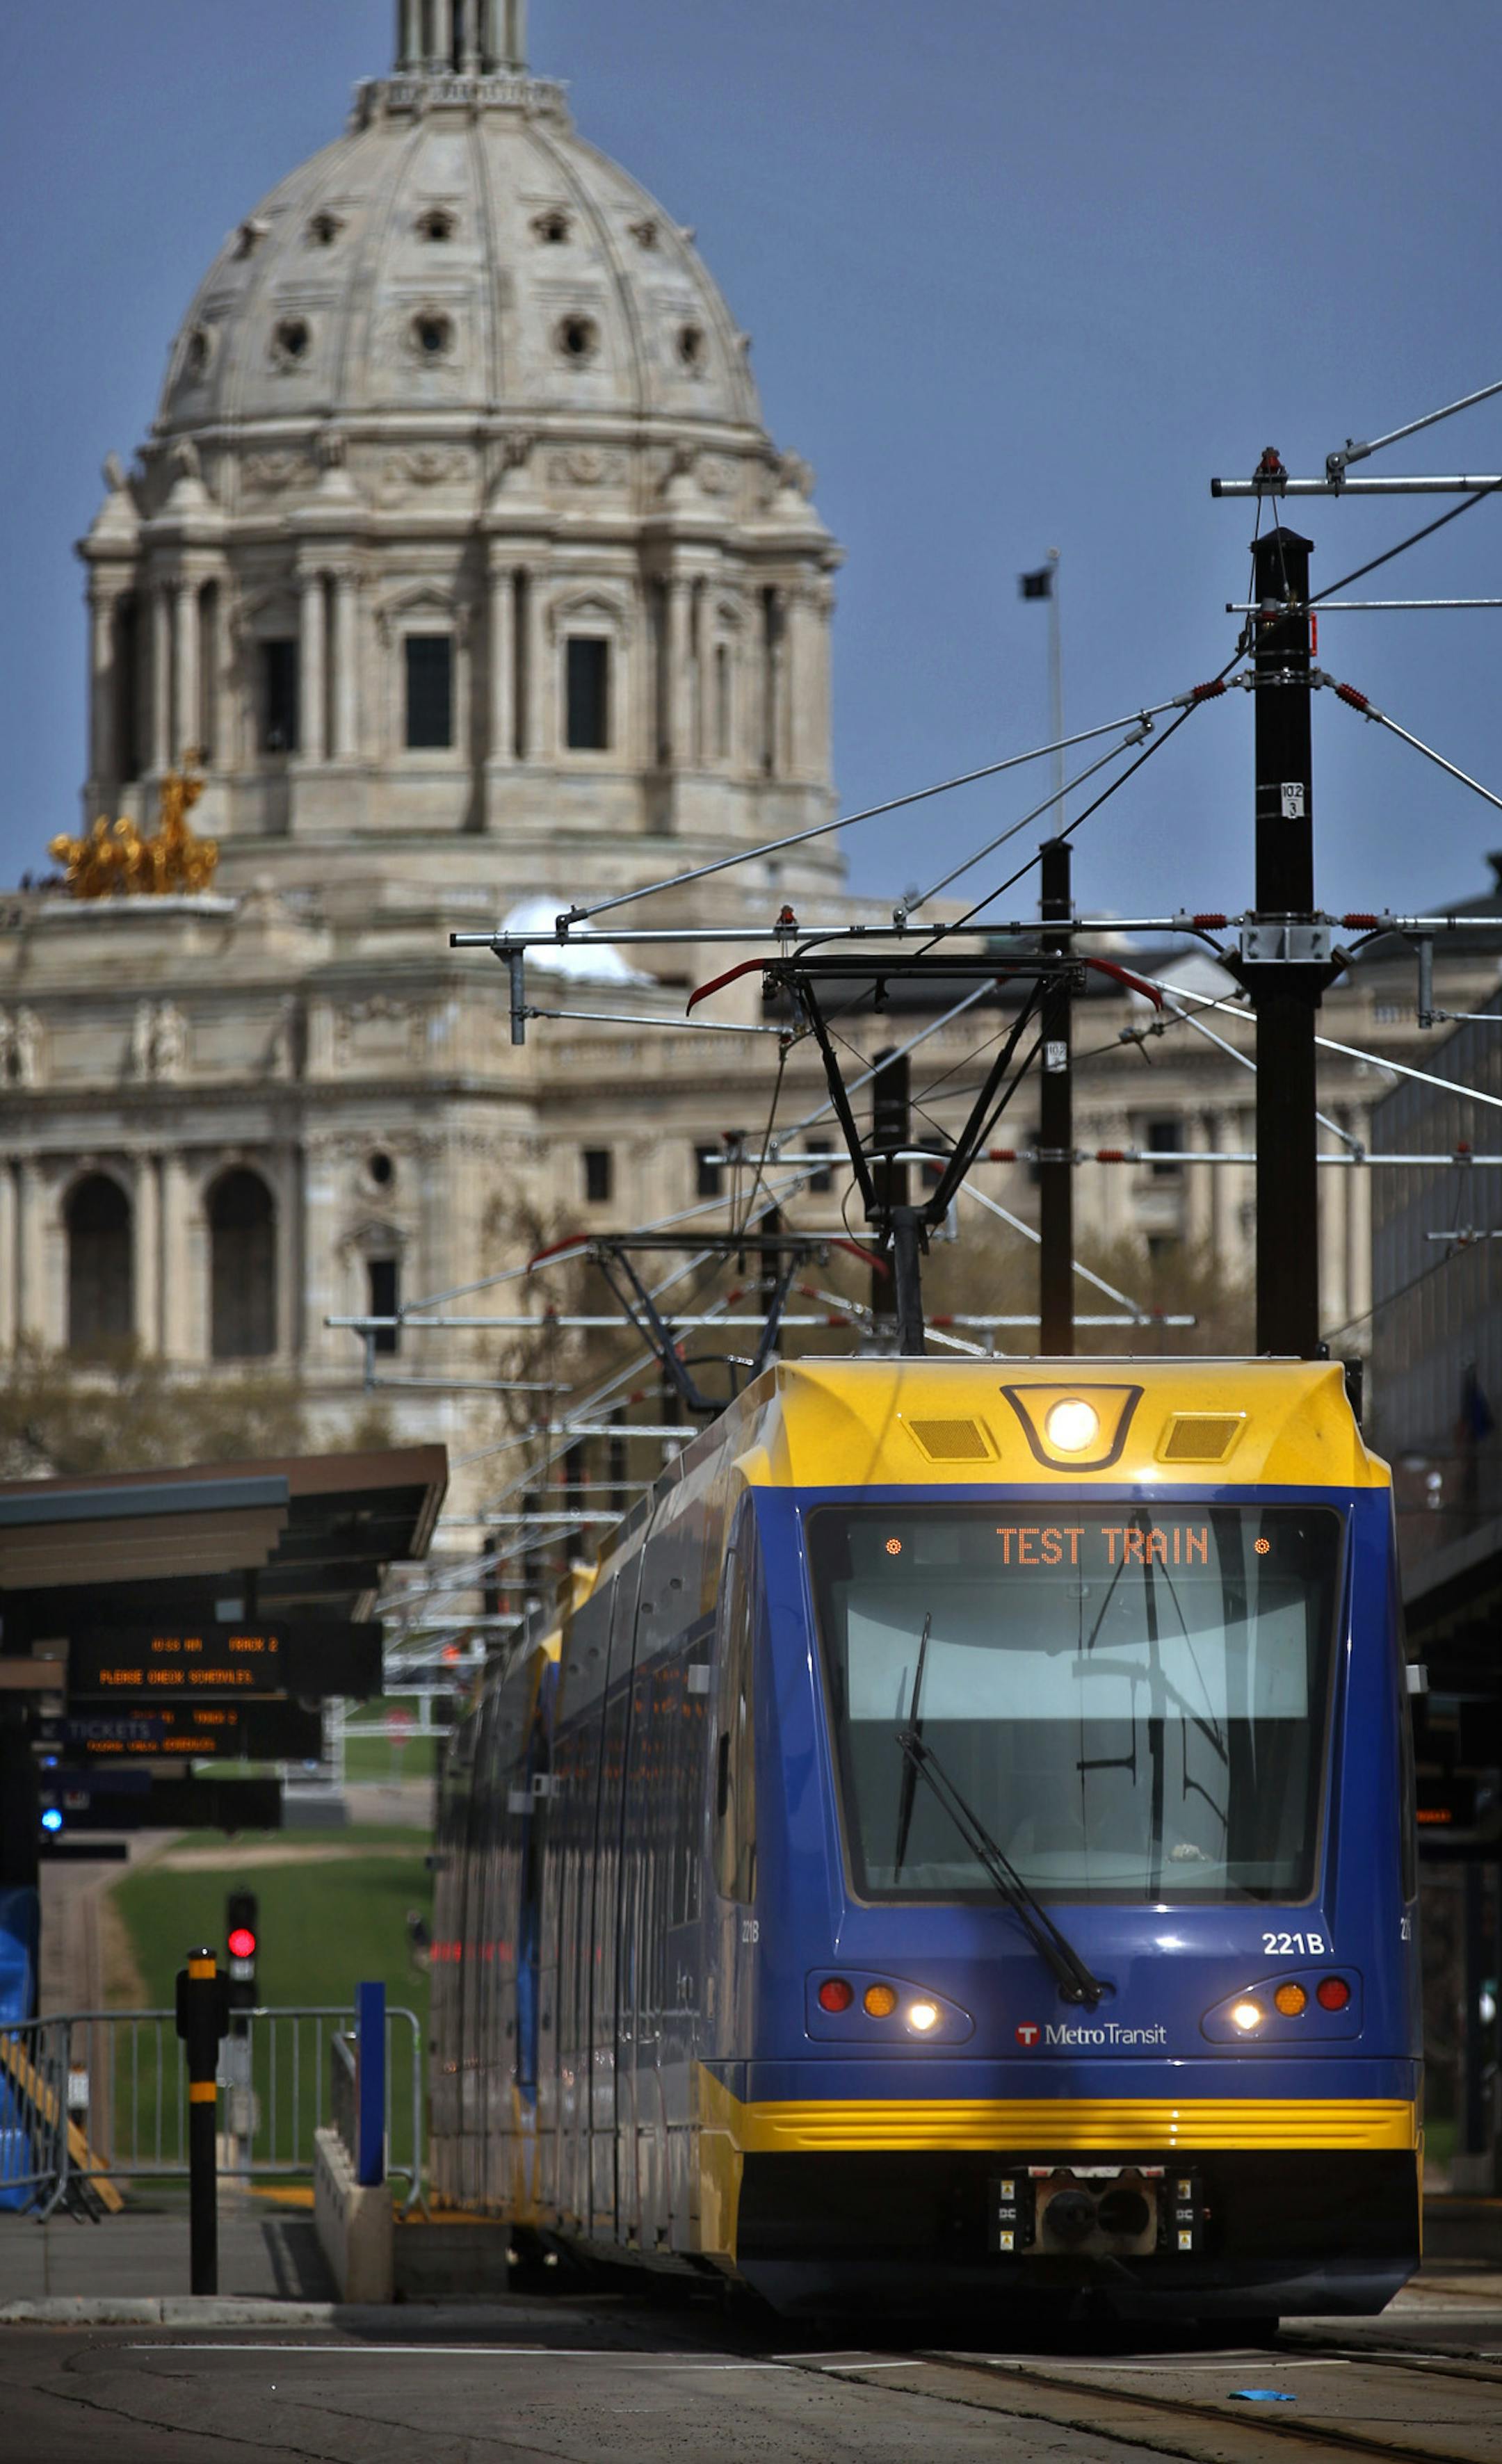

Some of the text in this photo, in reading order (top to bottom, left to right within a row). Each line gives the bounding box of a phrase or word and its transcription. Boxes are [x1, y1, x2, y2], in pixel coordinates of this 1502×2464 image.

[1289, 802, 1297, 816] 3
[996, 1527, 1208, 1564] TEST TRAIN
[229, 1637, 264, 1652] TRACK
[268, 1637, 278, 1652] 2
[99, 1669, 143, 1685] PLEASE
[147, 1669, 184, 1685] CHECK
[742, 1920, 759, 1943] 221B
[1261, 1933, 1325, 1955] 221B
[1044, 2024, 1105, 2045] Metro
[1104, 2023, 1168, 2044] Transit
[999, 2207, 1017, 2219] DC
